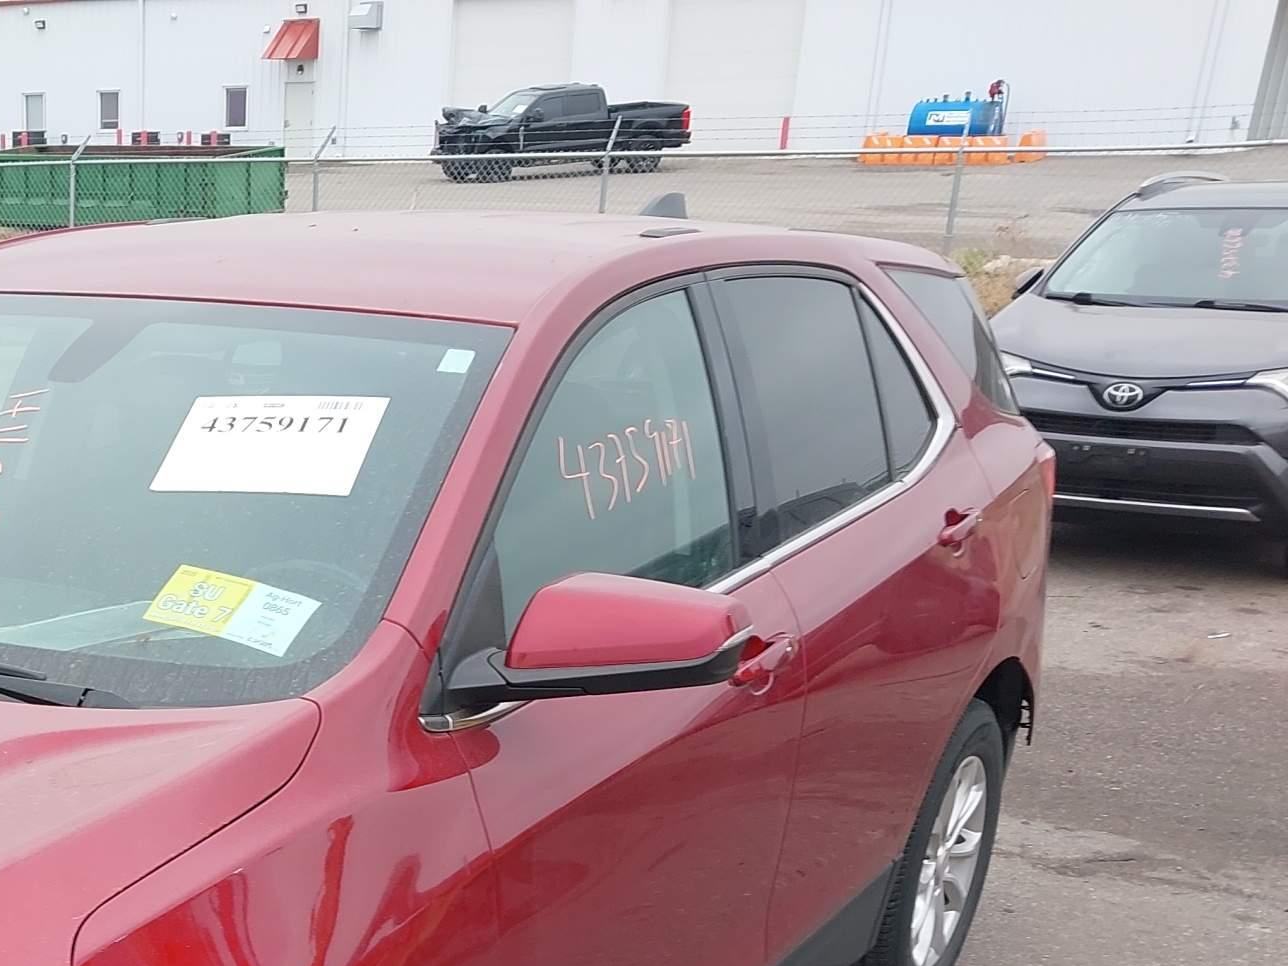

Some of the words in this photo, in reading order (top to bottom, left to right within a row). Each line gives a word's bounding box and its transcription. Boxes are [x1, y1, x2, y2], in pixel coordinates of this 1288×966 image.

[200, 415, 349, 433] 43759171
[557, 418, 697, 521] 43759171
[158, 594, 210, 619] Gate
